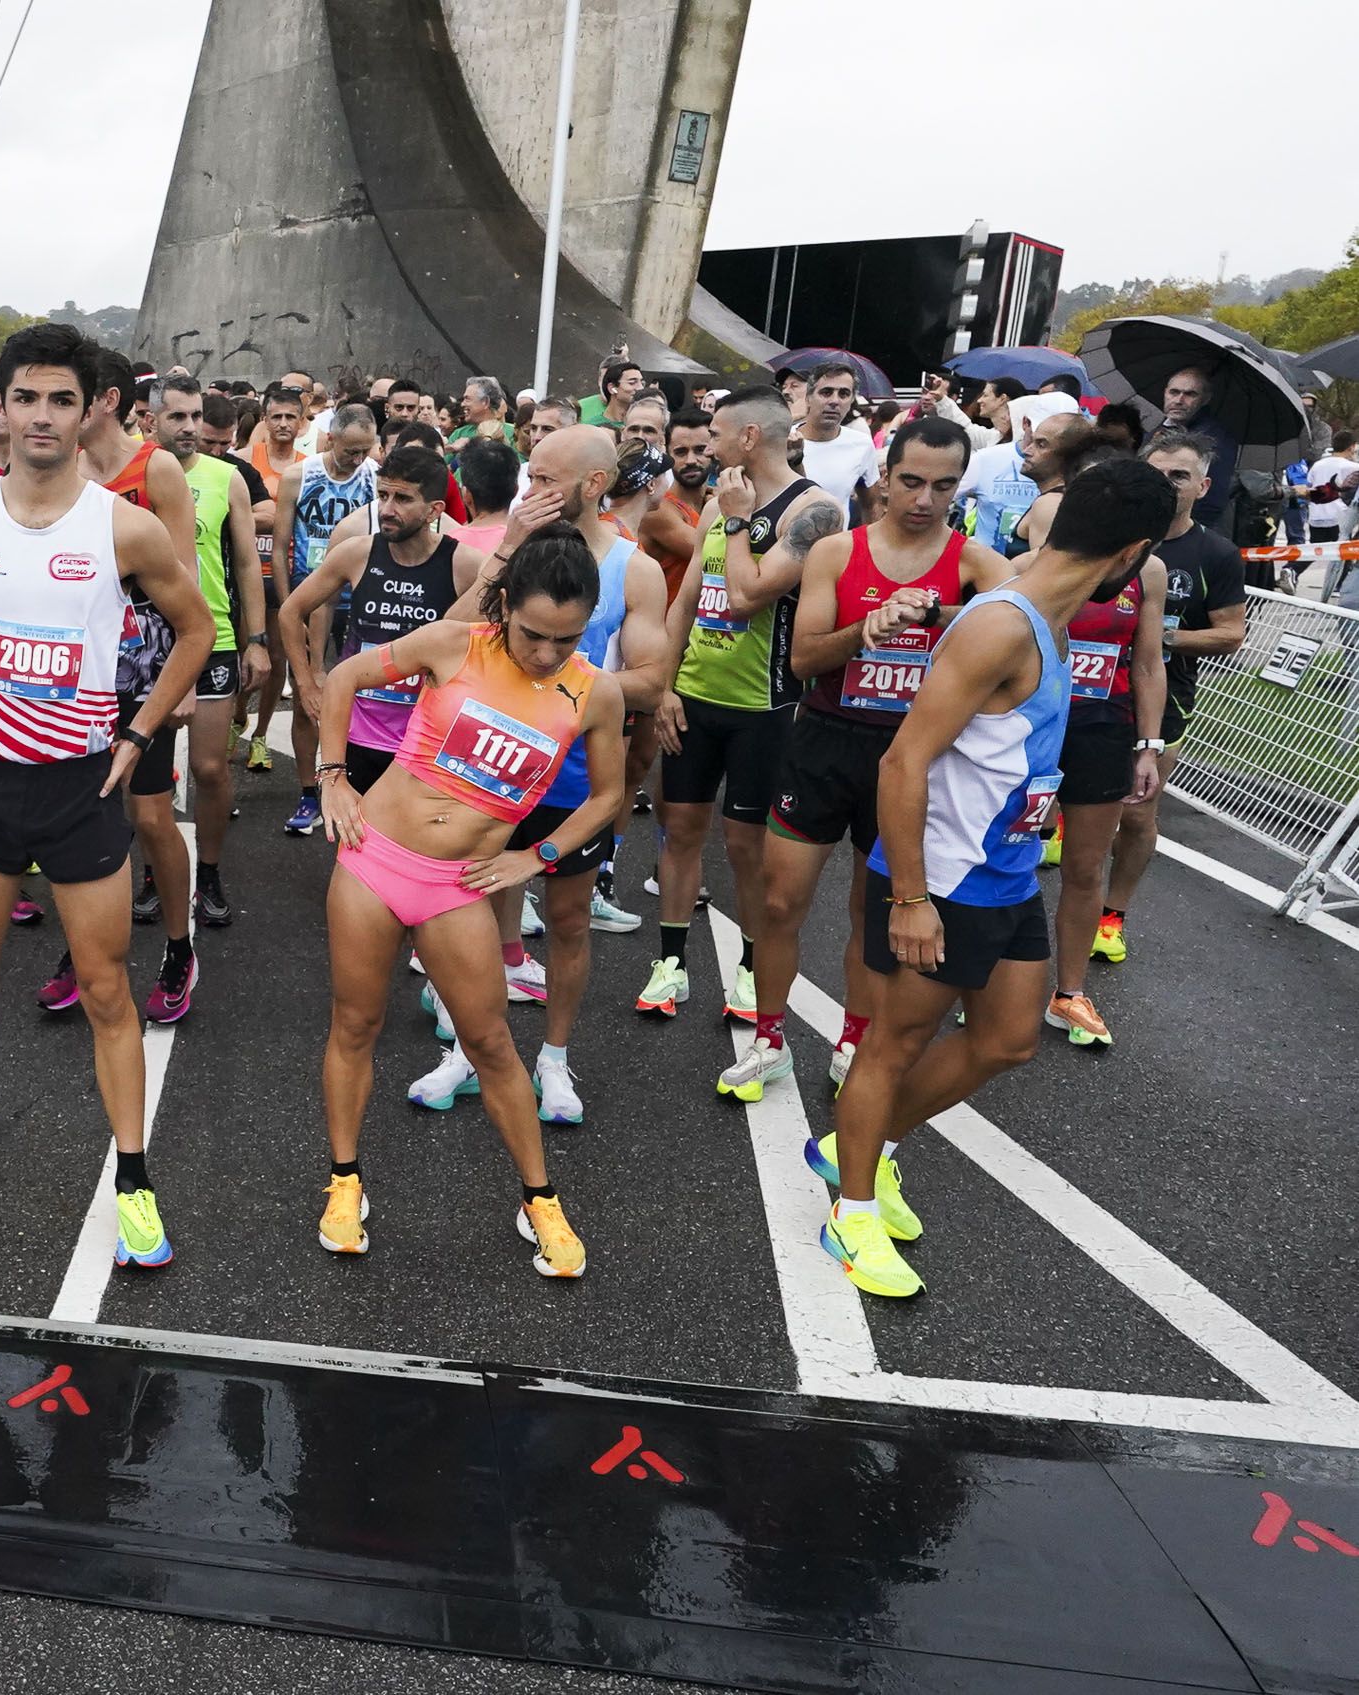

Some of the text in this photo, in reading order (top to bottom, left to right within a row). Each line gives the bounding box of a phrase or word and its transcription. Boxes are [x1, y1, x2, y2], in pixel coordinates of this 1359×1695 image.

[57, 568, 88, 576] SANTIAGO
[58, 558, 91, 567] ATLETISMO
[365, 600, 438, 621] O BARCO
[0, 638, 71, 677] 2006
[1071, 654, 1105, 680] 22
[858, 663, 922, 692] 2014
[471, 728, 531, 776] 1111
